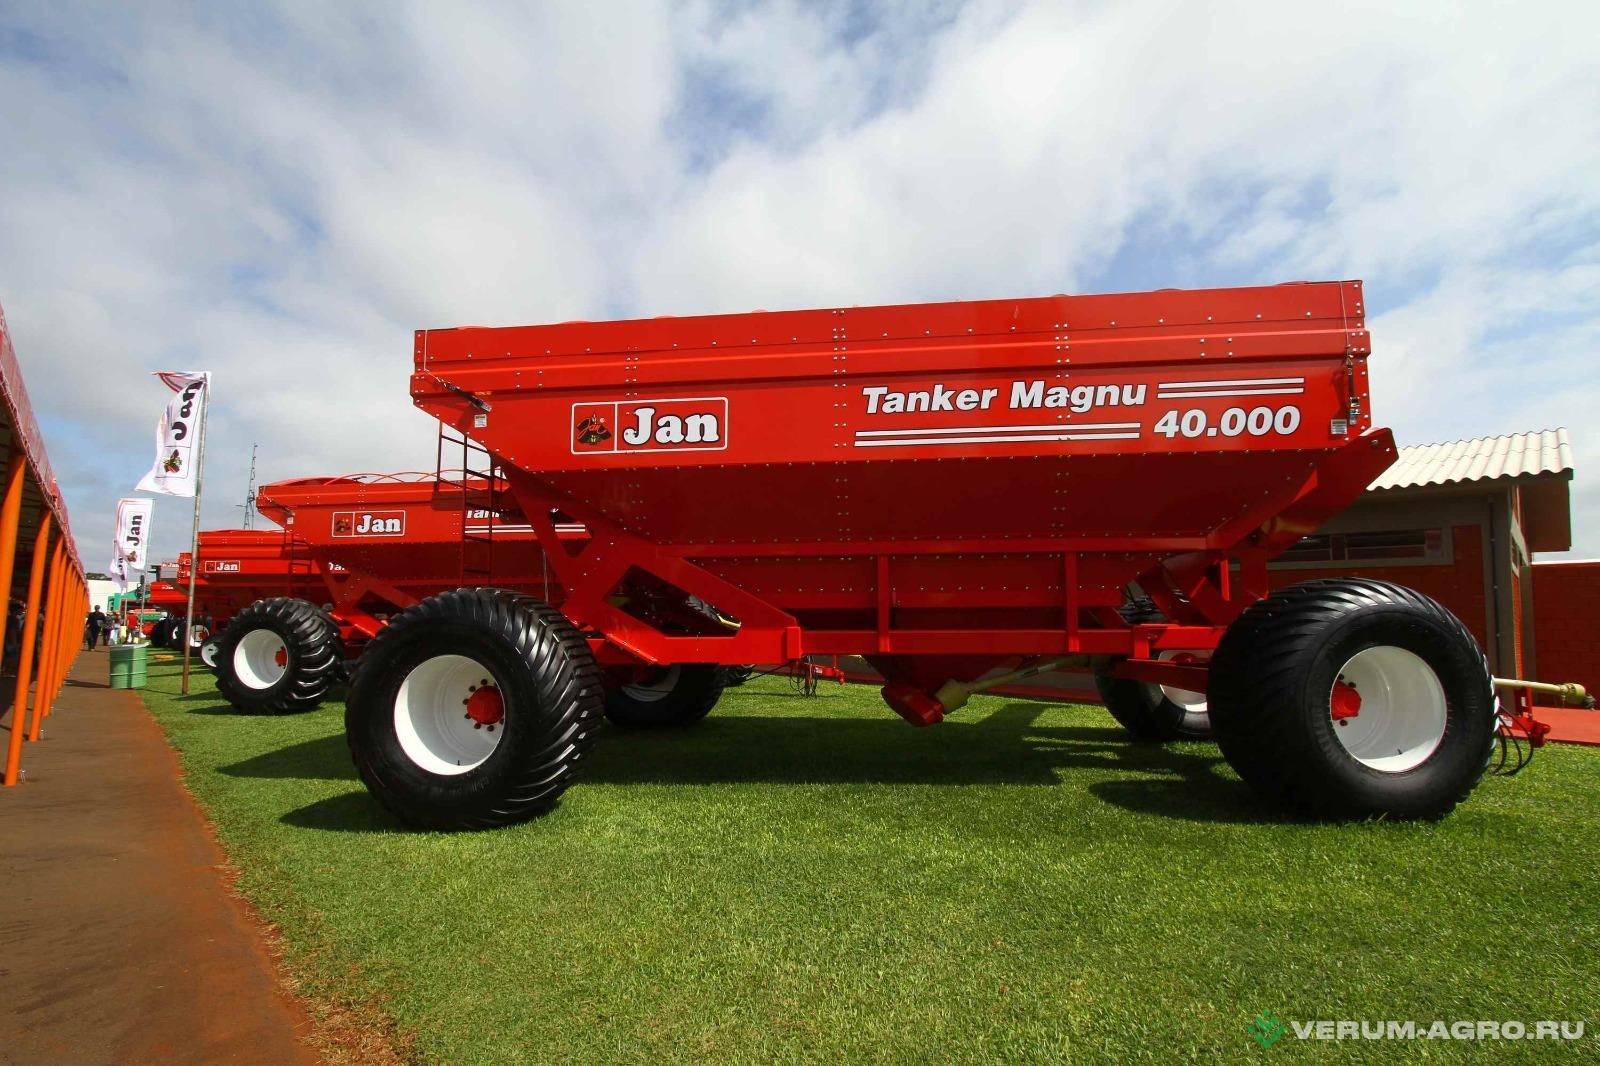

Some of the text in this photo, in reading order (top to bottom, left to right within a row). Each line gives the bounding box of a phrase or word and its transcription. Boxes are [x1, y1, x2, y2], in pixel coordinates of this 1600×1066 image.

[171, 380, 204, 441] Jan
[861, 380, 1148, 415] Tanker Magnu
[622, 406, 720, 446] Jan
[1153, 405, 1302, 439] 40.000
[126, 515, 143, 546] Jan
[356, 514, 401, 533] Jan
[216, 562, 238, 571] Jan
